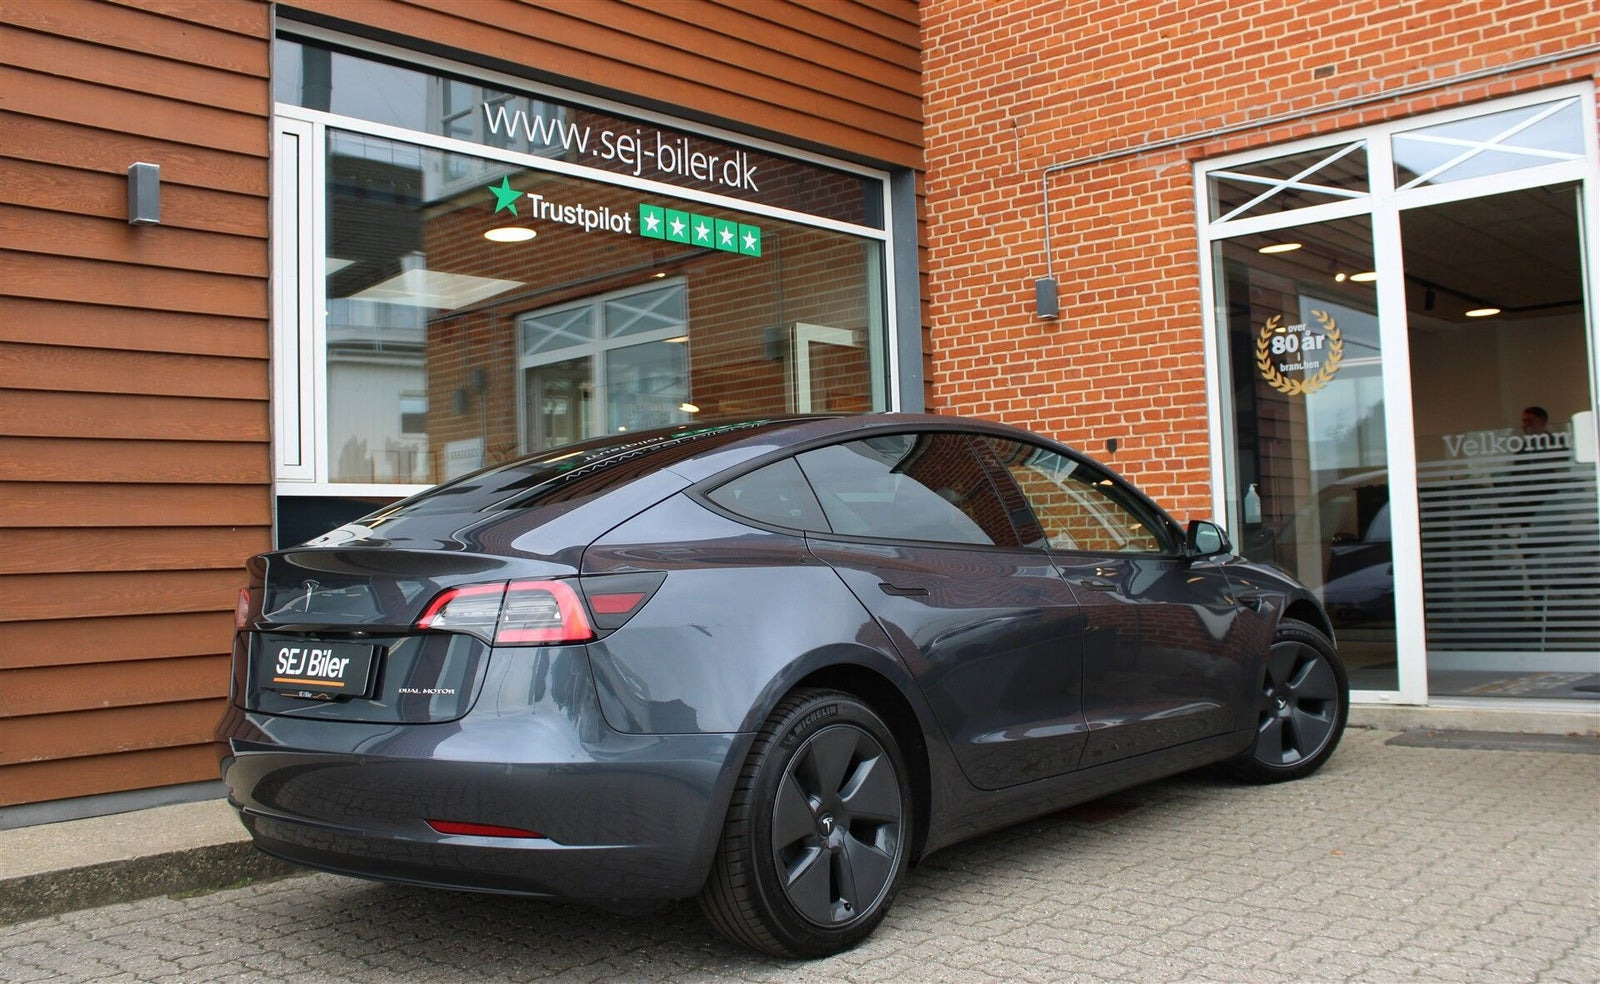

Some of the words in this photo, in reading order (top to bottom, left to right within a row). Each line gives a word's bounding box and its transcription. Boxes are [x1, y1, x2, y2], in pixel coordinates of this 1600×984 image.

[483, 102, 760, 192] www.sej-biler.dk
[527, 193, 632, 234] Trustpilot
[1272, 334, 1299, 354] 80
[1301, 330, 1325, 351] år
[1288, 324, 1306, 333] over
[276, 647, 304, 674] SEJ
[306, 649, 349, 678] Biler
[795, 705, 837, 735] MICHELIN
